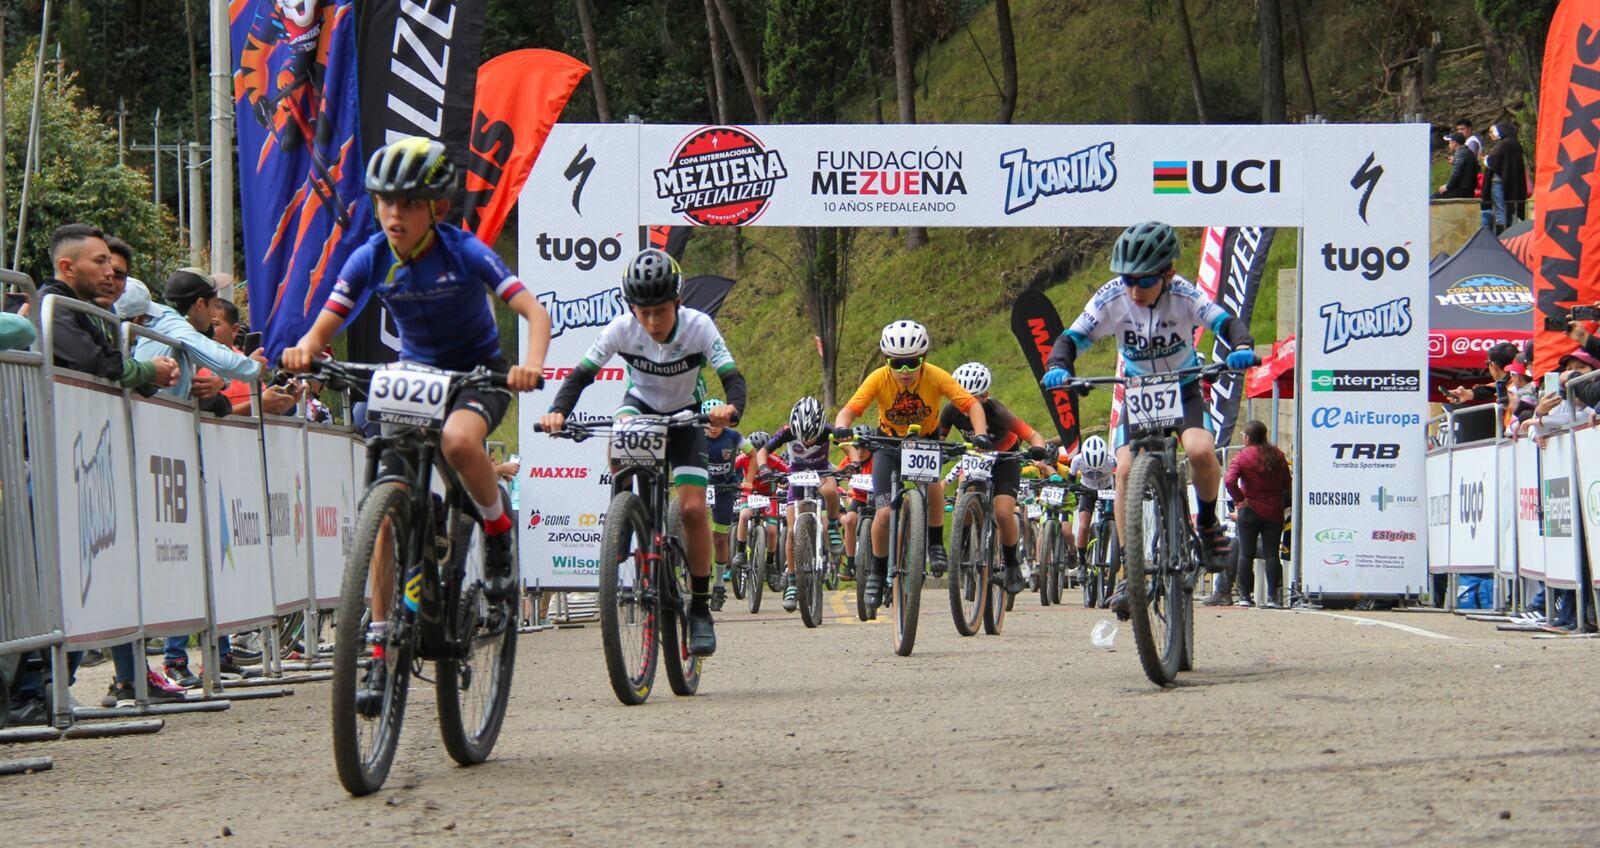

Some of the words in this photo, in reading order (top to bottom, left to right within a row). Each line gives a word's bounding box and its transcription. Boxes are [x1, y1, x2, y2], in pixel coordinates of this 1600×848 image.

[680, 157, 699, 166] COPA
[699, 147, 756, 162] INTERNACIONAL
[817, 146, 962, 170] FUNDACIÓN
[654, 150, 787, 198] MEZUENA
[811, 171, 967, 195] MEZUENA
[1000, 141, 1117, 215] ZUCARITAS
[1192, 159, 1281, 194] UCI
[672, 180, 775, 213] SPECIALIZED
[824, 202, 836, 212] 10
[838, 199, 873, 212] AÑOS
[876, 202, 955, 212] PEDALEANDO
[1435, 291, 1536, 306] MEZUEN
[1446, 286, 1474, 294] COPA
[1479, 285, 1530, 293] FAMILIAR
[1320, 297, 1412, 354] ZUCARITAS
[1124, 329, 1183, 350] BORA
[542, 367, 625, 380] SRM
[1317, 373, 1418, 389] enterprise
[374, 376, 443, 405] 3020
[1130, 389, 1177, 414] 3057
[1343, 410, 1420, 427] AirEuropa
[614, 431, 663, 450] 3065
[1331, 443, 1401, 459] TRB
[907, 454, 937, 470] 3016
[1359, 461, 1397, 471] Sportswear
[529, 467, 588, 478] MAXXIS
[150, 455, 188, 524] TRB
[1308, 492, 1360, 505] ROCKSHOX
[544, 514, 570, 526] GOING
